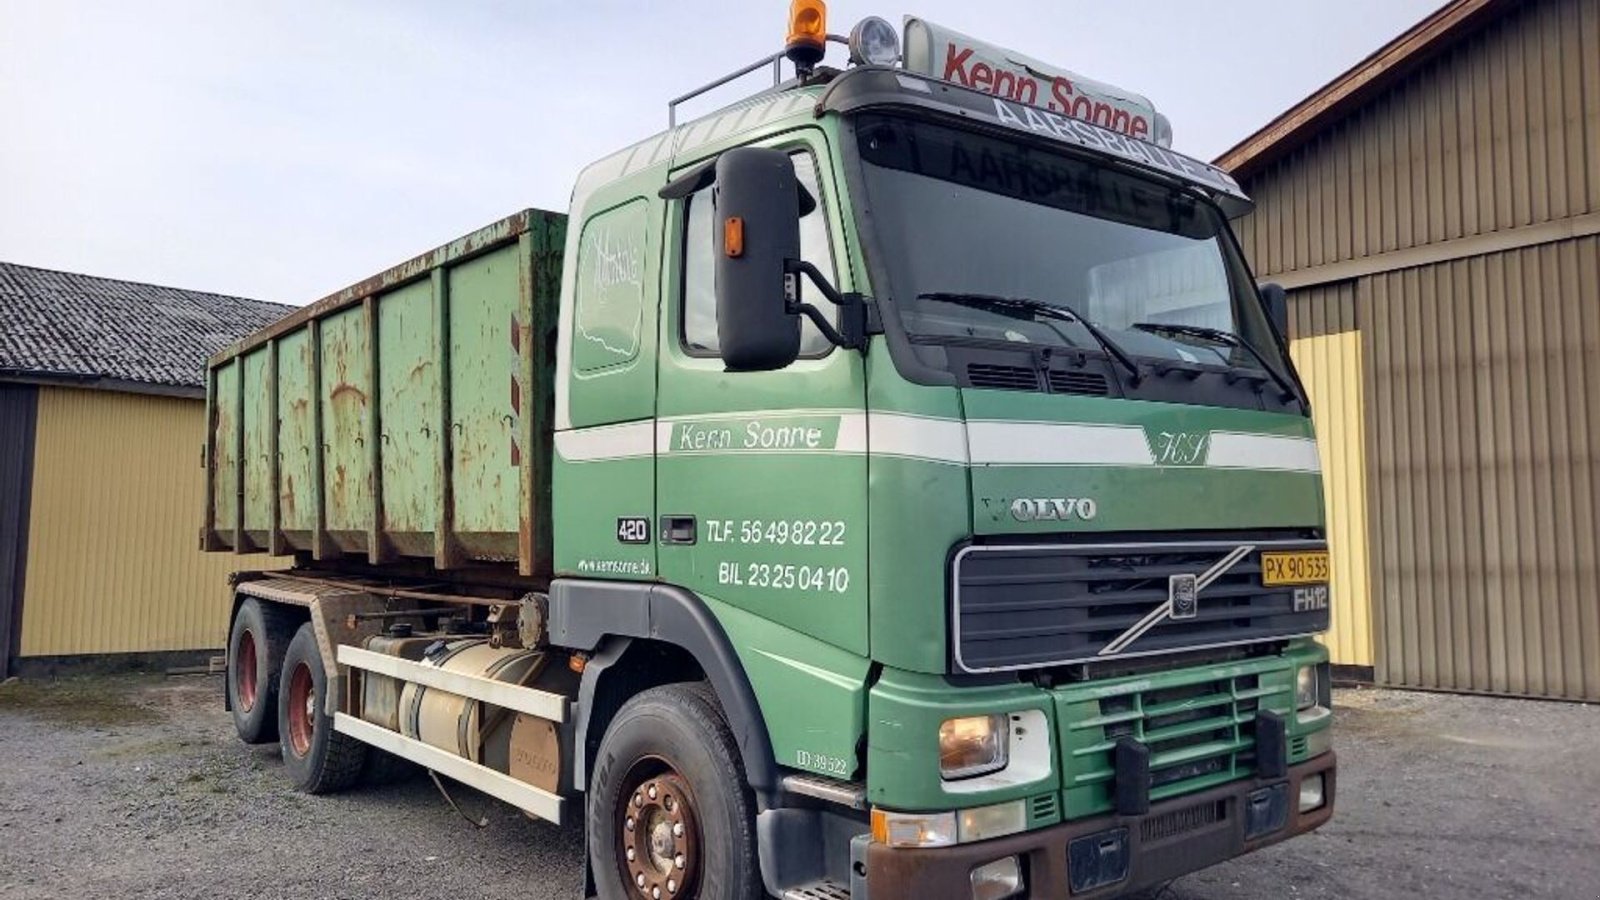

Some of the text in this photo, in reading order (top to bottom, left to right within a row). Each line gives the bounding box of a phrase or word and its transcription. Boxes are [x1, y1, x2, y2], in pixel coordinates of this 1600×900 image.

[944, 43, 1148, 138] Kenn Sonne
[743, 421, 822, 448] Sonne
[618, 520, 646, 540] 420
[706, 520, 734, 542] TLF.
[718, 562, 743, 584] BIL
[1266, 557, 1328, 579] PX 90 533
[1294, 587, 1327, 612] FH12
